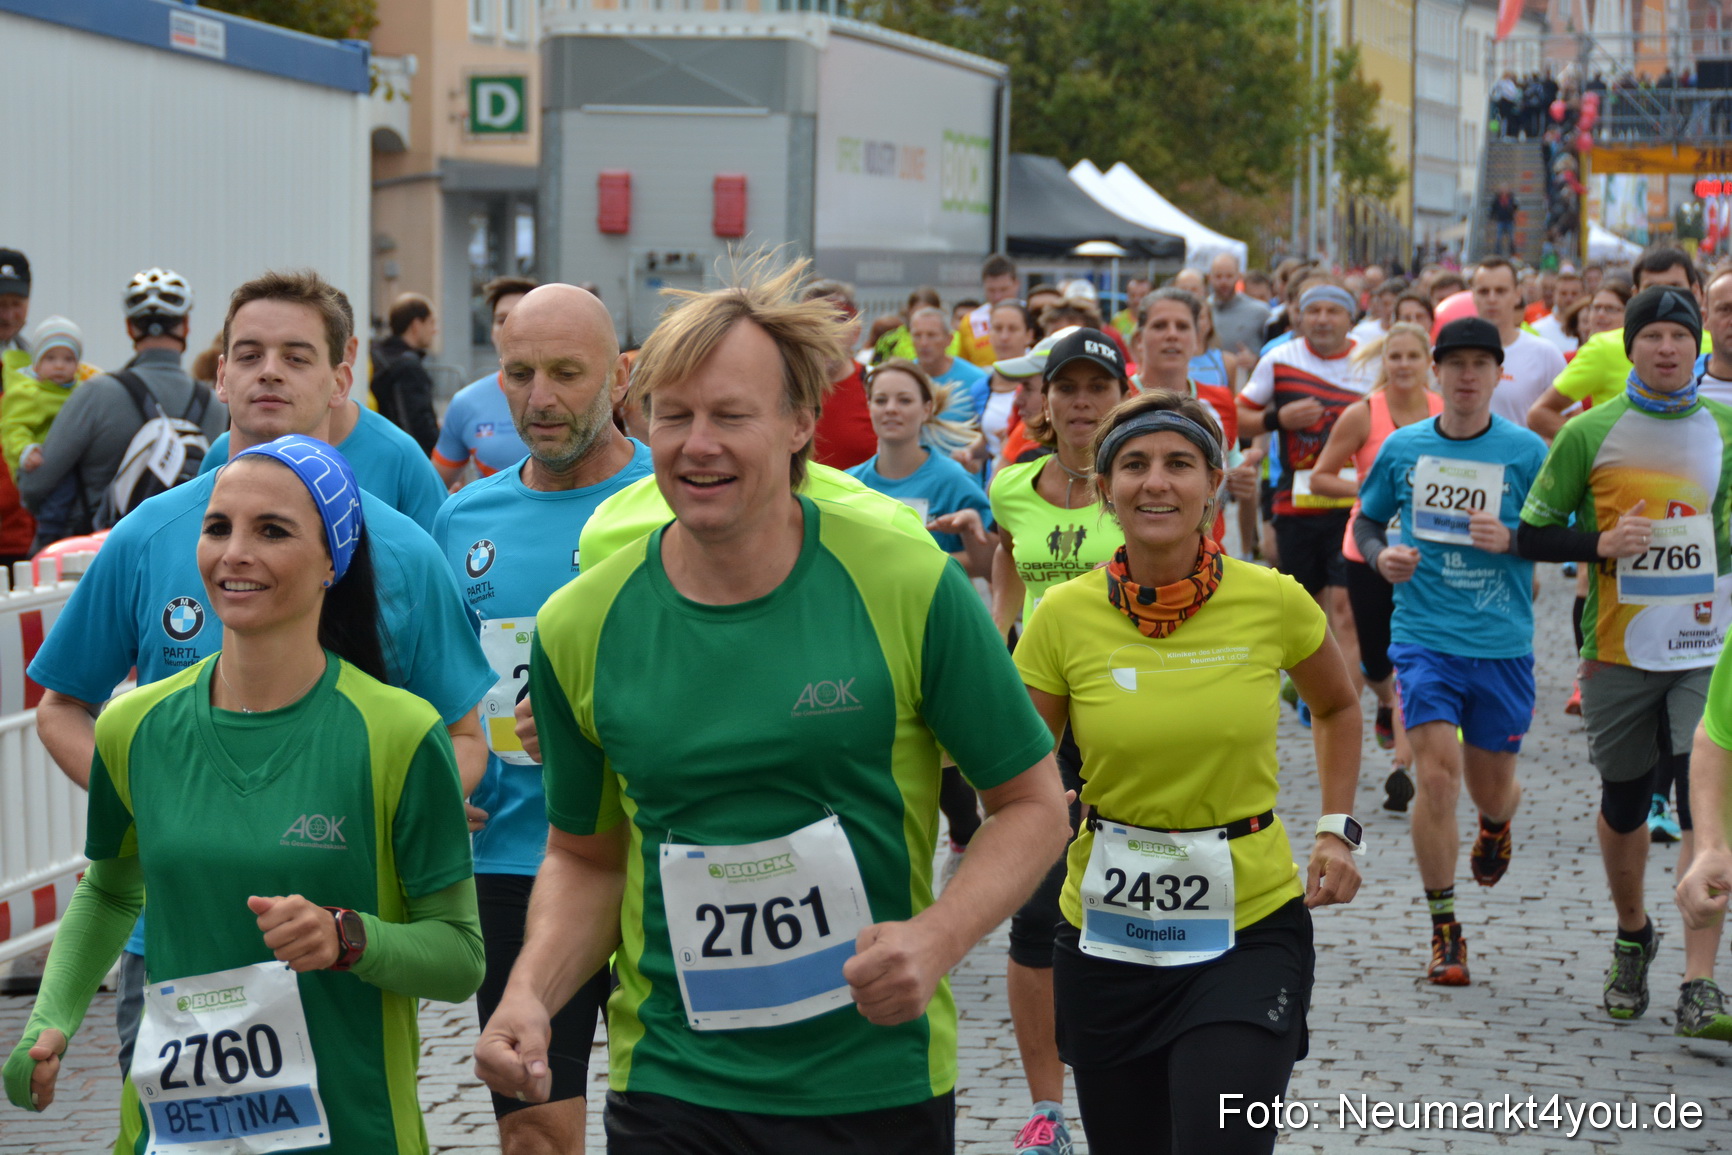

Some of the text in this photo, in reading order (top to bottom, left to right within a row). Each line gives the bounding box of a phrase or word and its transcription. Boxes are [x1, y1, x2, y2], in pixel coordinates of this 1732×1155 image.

[477, 83, 519, 128] D
[1425, 483, 1486, 511] 2320
[1433, 516, 1469, 530] Wolfgan
[469, 540, 494, 556] BMW
[1442, 552, 1467, 568] 18.
[1632, 544, 1701, 571] 2766
[467, 581, 494, 597] PARTL
[166, 598, 202, 613] BMW
[163, 647, 200, 659] PARTL
[1167, 650, 1197, 659] Kliniken
[1190, 655, 1225, 664] Neumarkt
[793, 677, 860, 711] AOK
[282, 814, 347, 842] AOK
[1141, 840, 1189, 857] BOCK
[724, 853, 795, 878] BOCK
[1102, 867, 1210, 912] 2432
[695, 885, 831, 958] 2761
[1125, 922, 1186, 941] Cornelia
[684, 952, 691, 962] D
[191, 986, 247, 1009] BOCK
[158, 1023, 283, 1091] 2760
[145, 1086, 153, 1097] D
